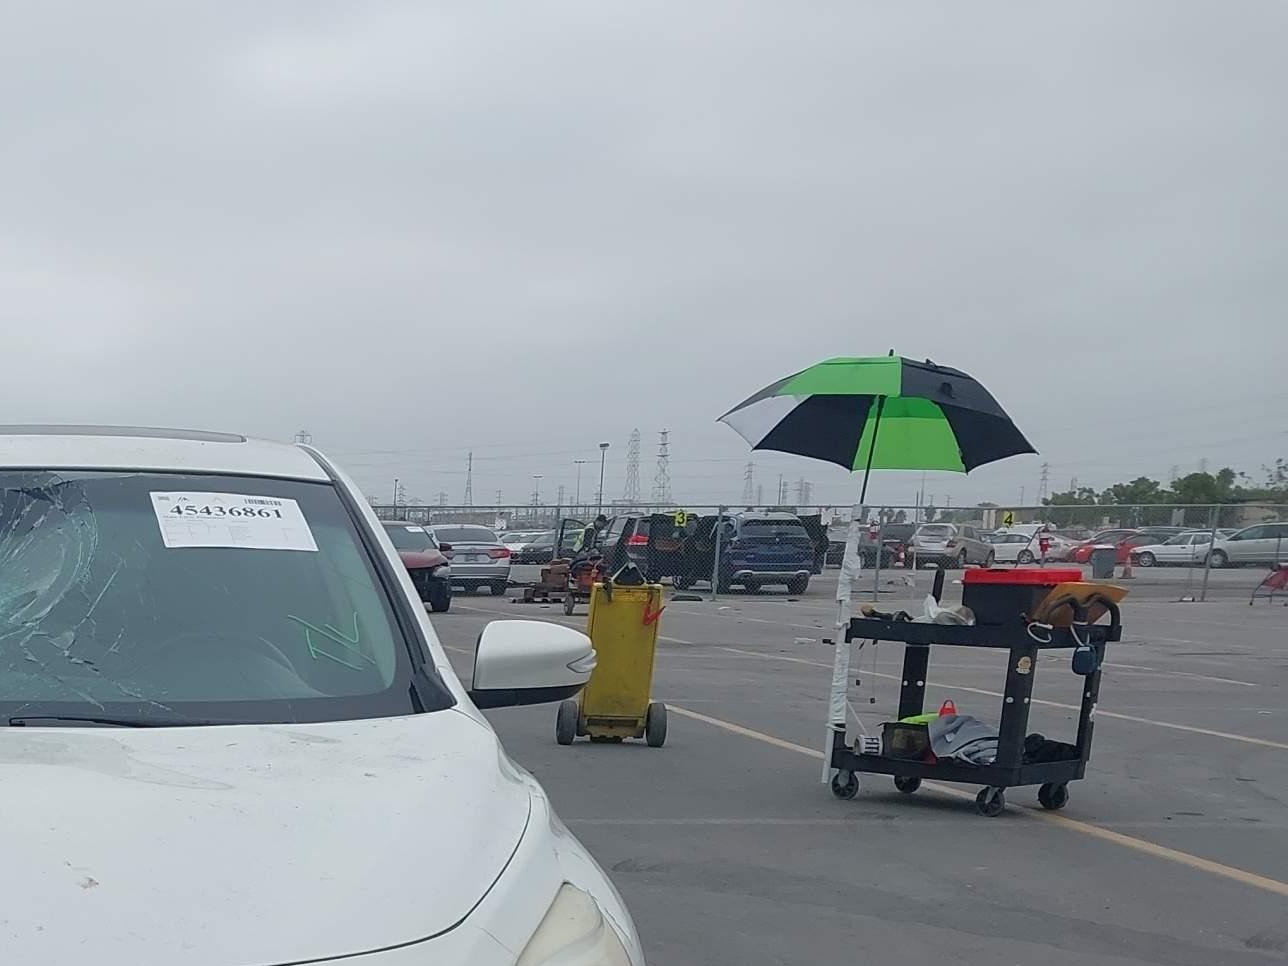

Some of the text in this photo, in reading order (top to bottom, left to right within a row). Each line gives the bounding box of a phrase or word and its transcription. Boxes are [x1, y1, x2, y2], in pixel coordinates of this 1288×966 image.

[170, 505, 282, 519] 45436861
[676, 511, 686, 525] 3
[1003, 511, 1013, 528] 4
